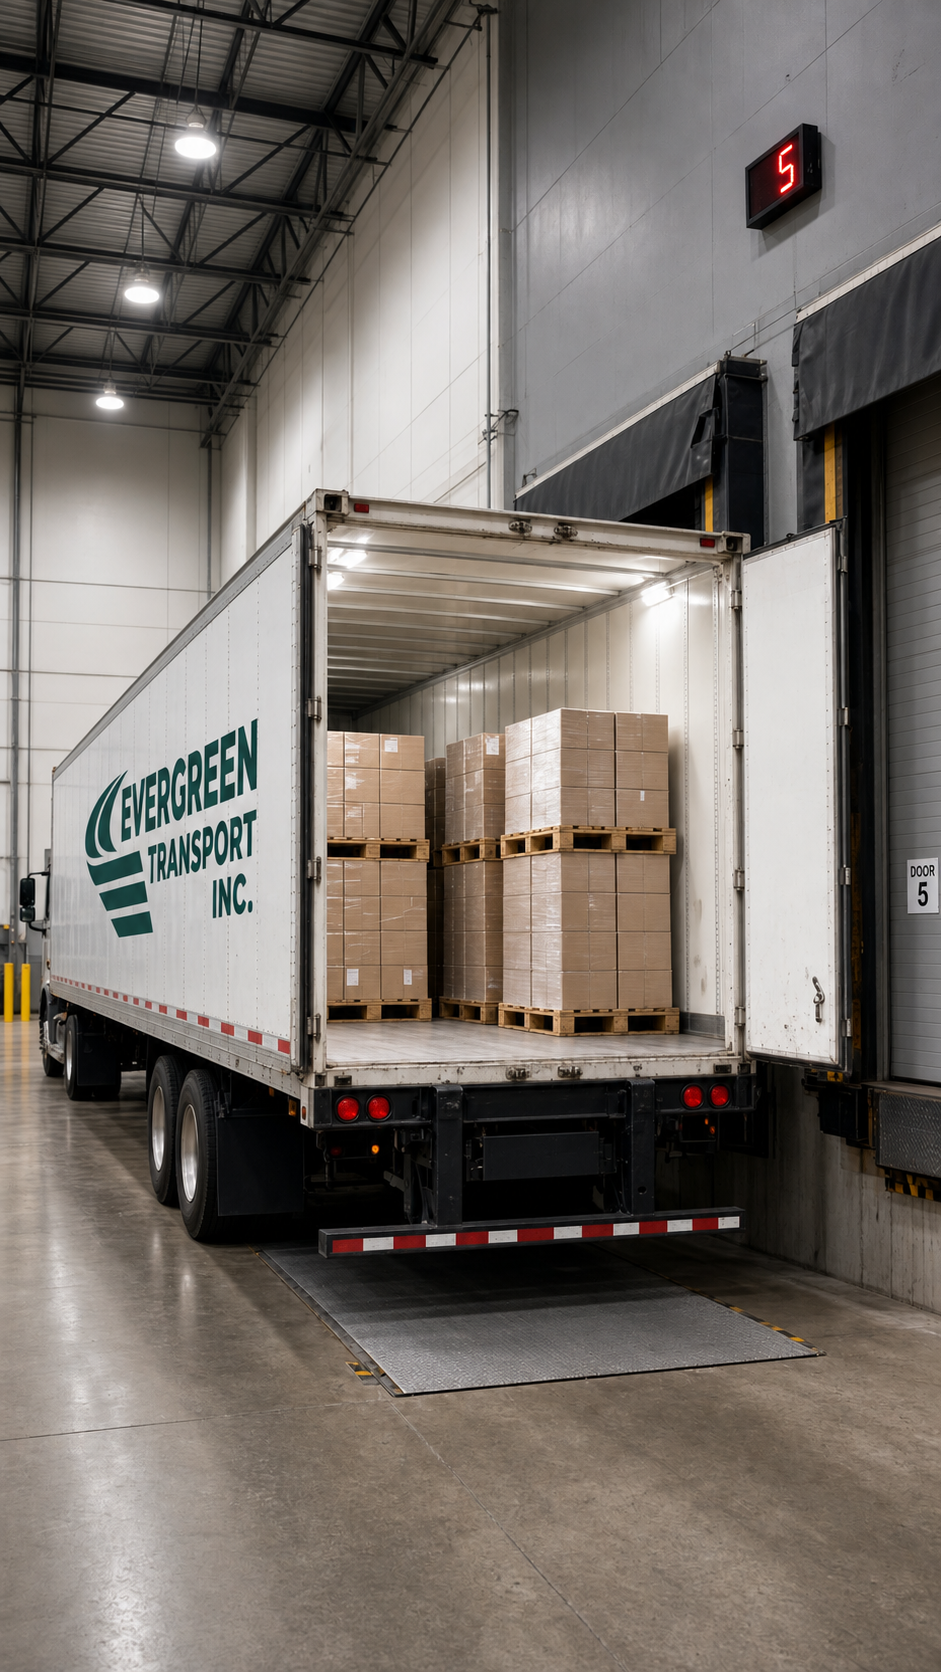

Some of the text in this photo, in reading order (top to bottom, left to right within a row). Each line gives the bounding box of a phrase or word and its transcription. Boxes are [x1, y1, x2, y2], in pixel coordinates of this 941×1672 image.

[778, 144, 794, 193] 5
[121, 718, 258, 843] EVERGREEN
[147, 809, 257, 884] TRANSPORT
[910, 865, 935, 877] DOOR
[918, 881, 928, 906] 5
[213, 873, 253, 918] INC.
